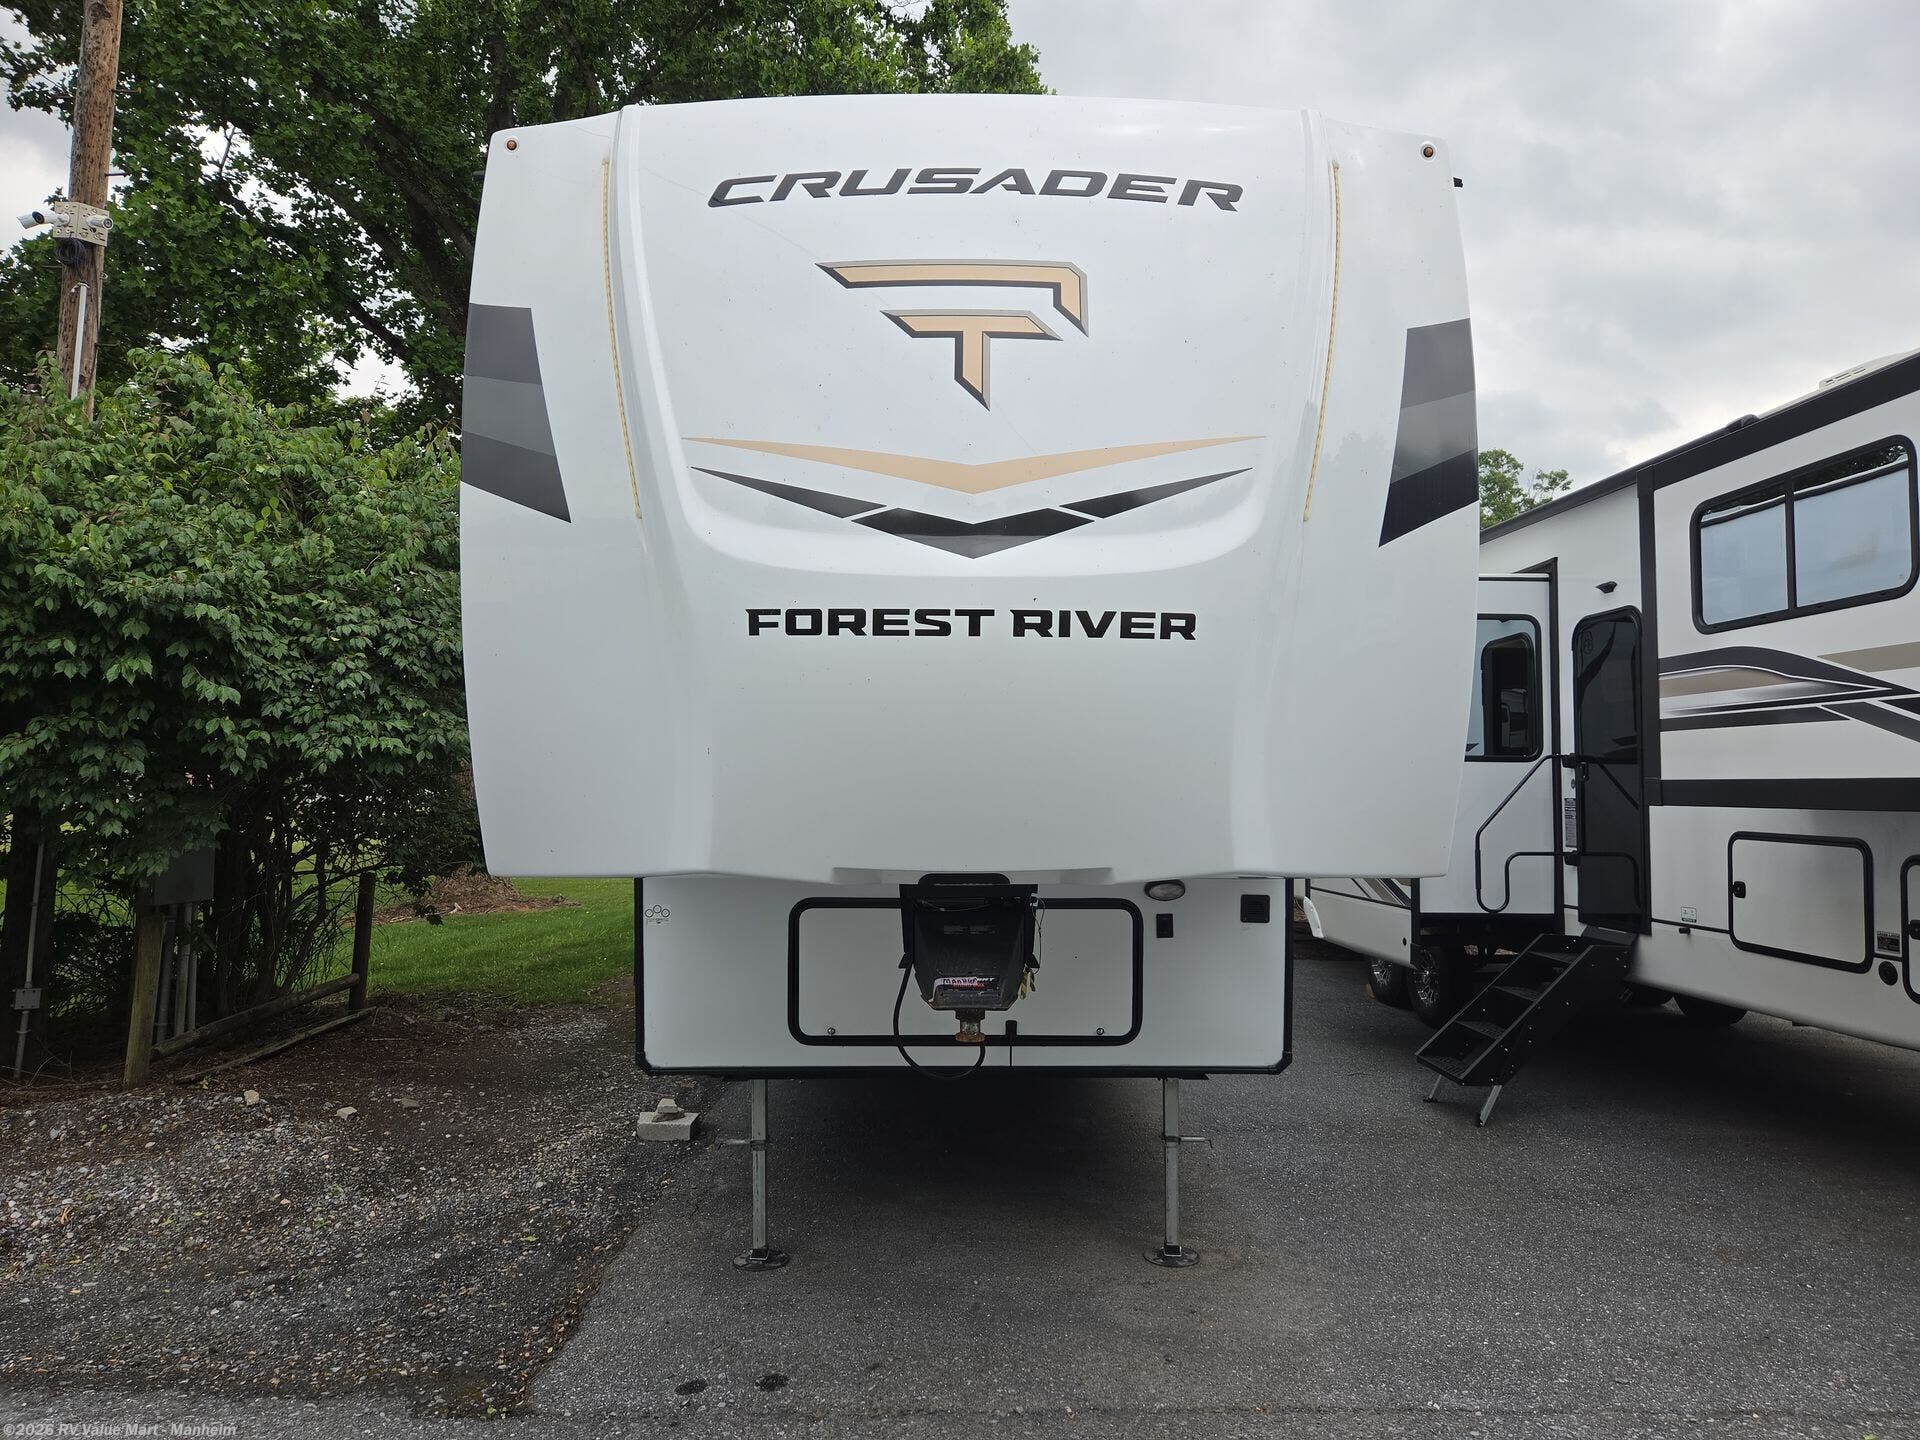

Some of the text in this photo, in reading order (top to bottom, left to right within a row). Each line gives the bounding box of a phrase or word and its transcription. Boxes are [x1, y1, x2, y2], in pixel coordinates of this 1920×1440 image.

[708, 168, 1243, 211] CRUSADER
[745, 609, 1196, 640] FOREST RIVER
